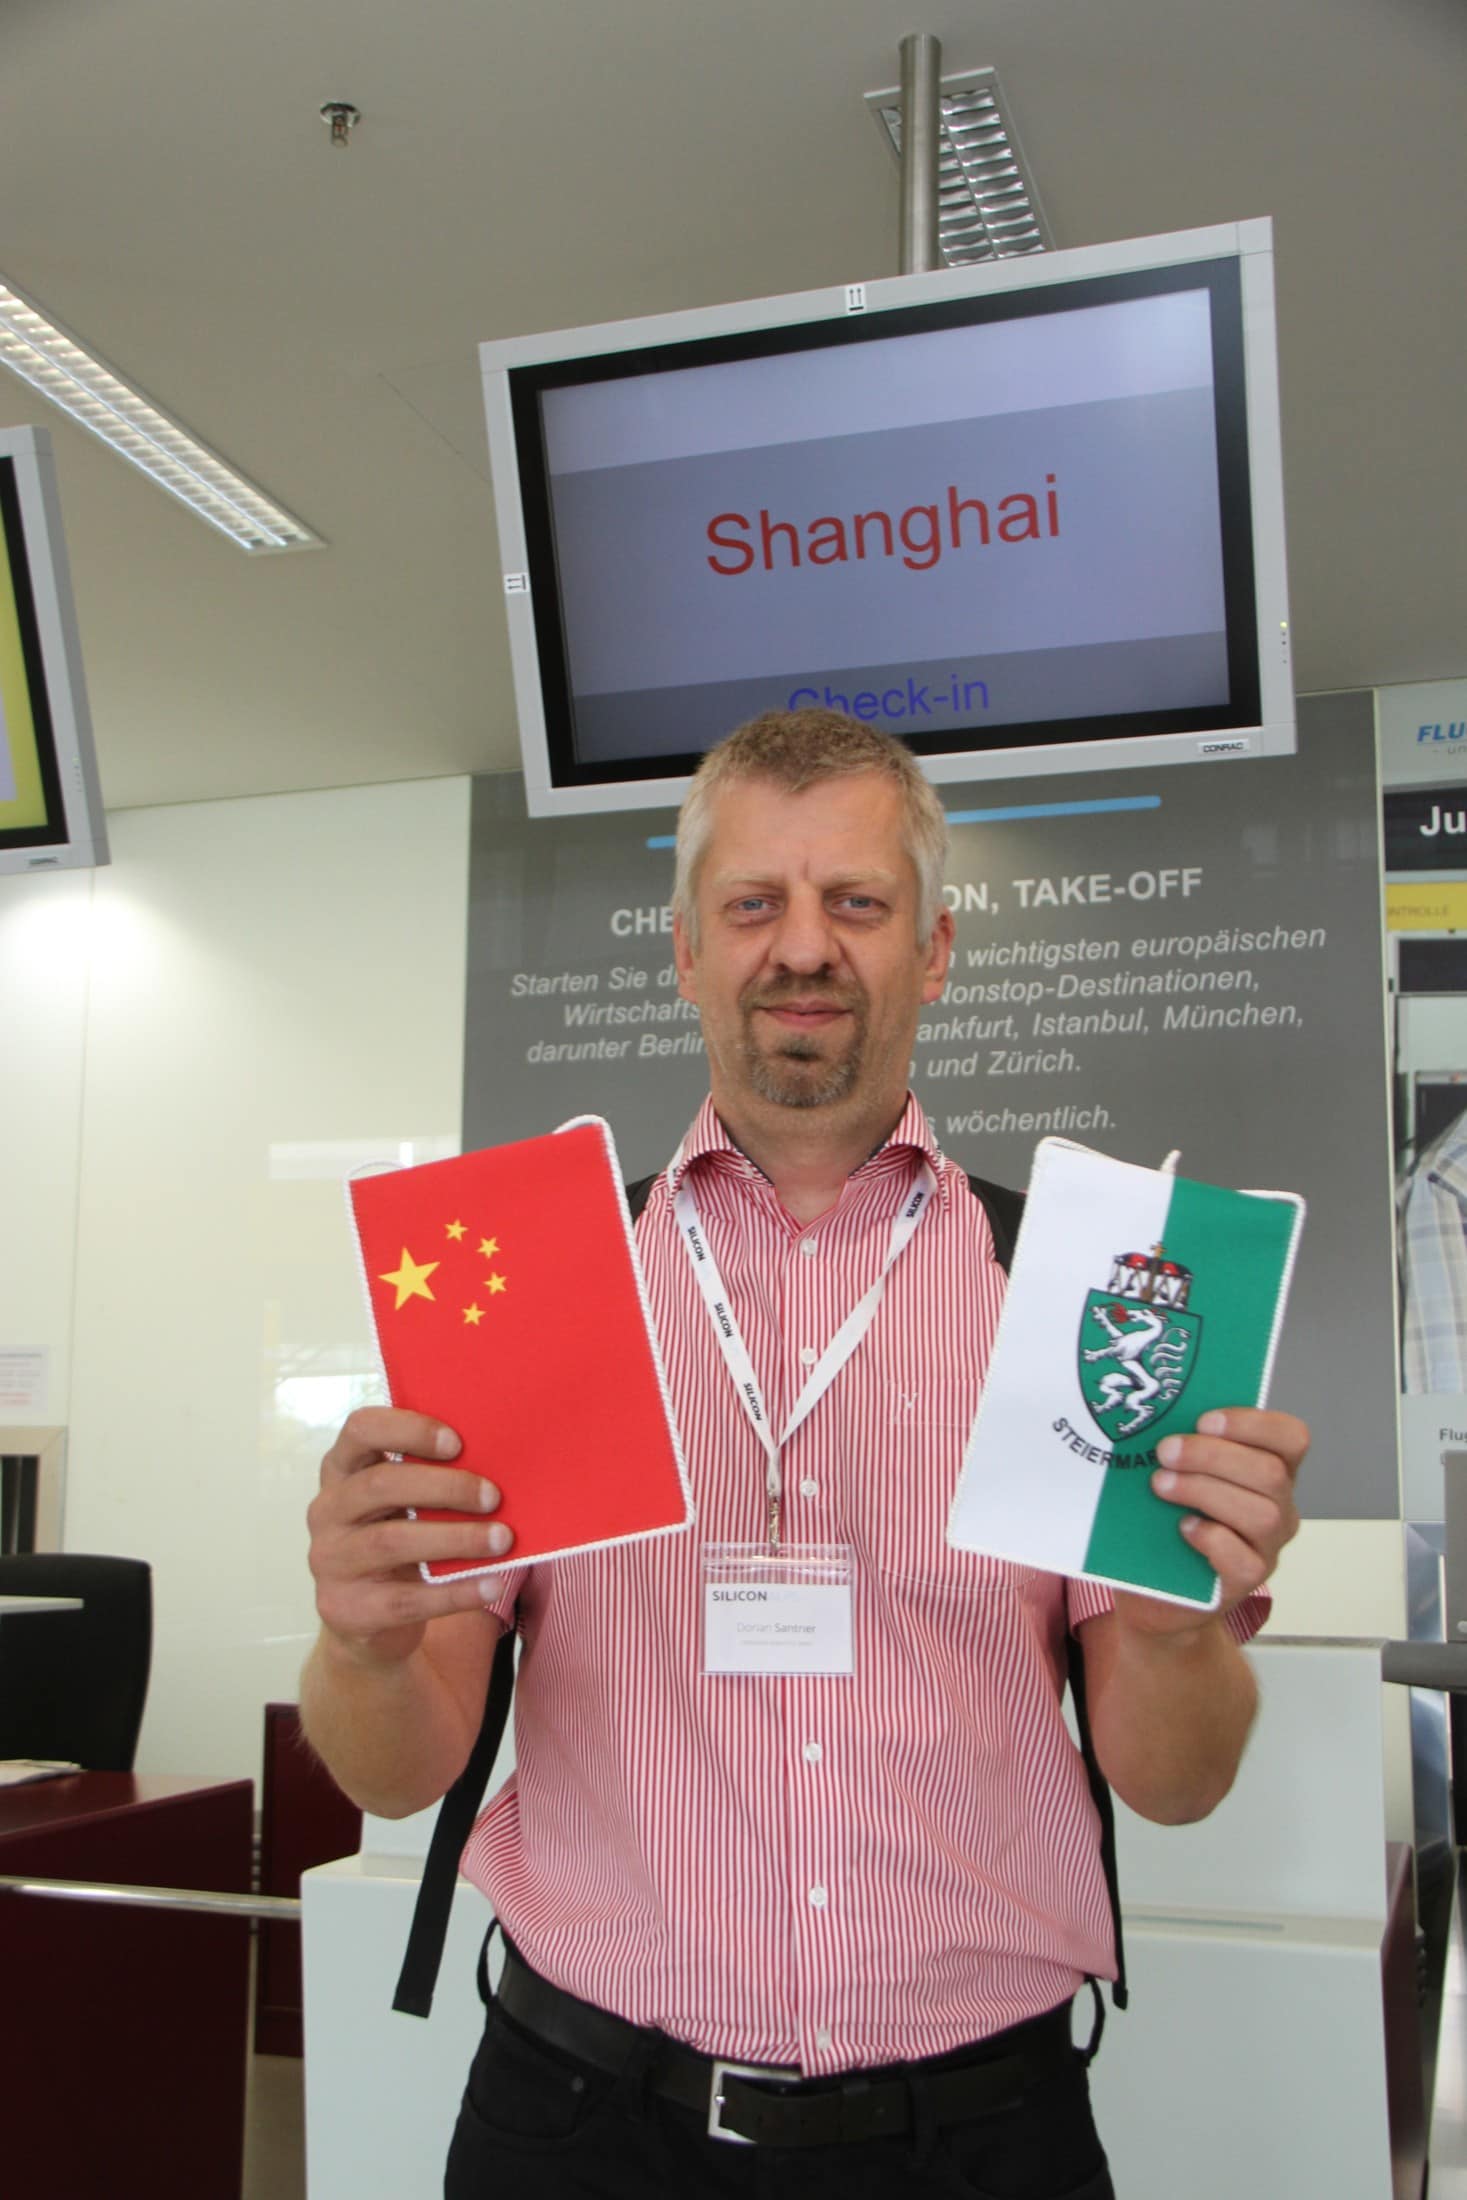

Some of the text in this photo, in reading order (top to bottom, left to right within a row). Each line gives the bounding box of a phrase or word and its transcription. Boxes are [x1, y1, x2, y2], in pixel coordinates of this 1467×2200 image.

[706, 473, 1060, 576] Shanghai
[1013, 867, 1203, 908] TAKE-OFF
[511, 972, 599, 996] Starten
[608, 966, 648, 990] Sie
[967, 938, 1120, 970] wichtigsten
[1131, 925, 1327, 960] europäischen
[527, 1040, 632, 1063] darunter
[1032, 1007, 1149, 1036] Istanbul,
[1163, 1002, 1304, 1030] München,
[927, 1052, 978, 1078] und
[987, 1048, 1082, 1075] Zürich.
[946, 1104, 1117, 1134] wöchentlich.
[687, 1225, 706, 1262] SILICON
[714, 1302, 734, 1339] SILICON
[743, 1382, 763, 1422] SILICON
[712, 1590, 768, 1602] SILICON
